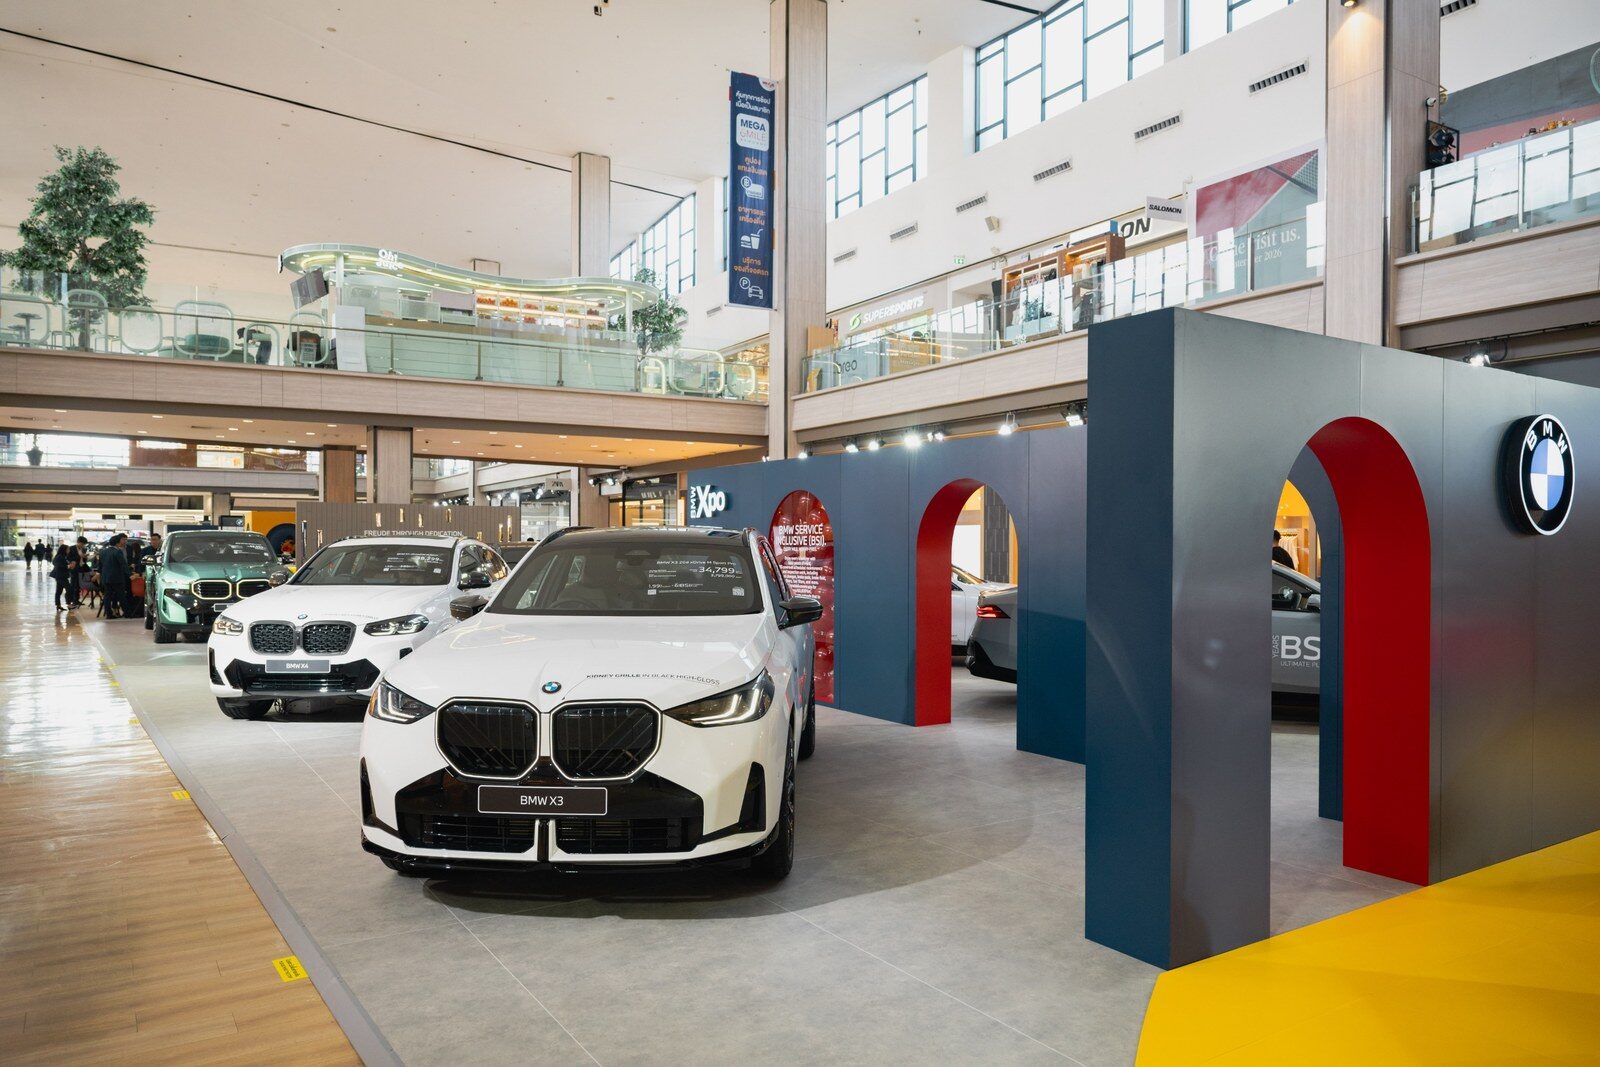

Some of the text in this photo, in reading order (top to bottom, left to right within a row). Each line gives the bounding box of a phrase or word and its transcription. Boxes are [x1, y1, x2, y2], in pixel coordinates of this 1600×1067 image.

[740, 119, 766, 132] MEGA
[1148, 204, 1182, 214] SALOMON
[1256, 228, 1277, 250] isit
[1281, 228, 1301, 244] us.
[863, 295, 924, 324] SUPERSPORTS
[1527, 420, 1568, 455] BMW
[696, 484, 726, 518] Xpo
[779, 524, 823, 535] BMW SERVICE
[698, 566, 735, 574] 34,799
[1271, 635, 1279, 659] YEARS
[1281, 635, 1320, 661] BS
[676, 674, 720, 685] HIGH-GLOSS
[520, 795, 564, 806] BMW X3
